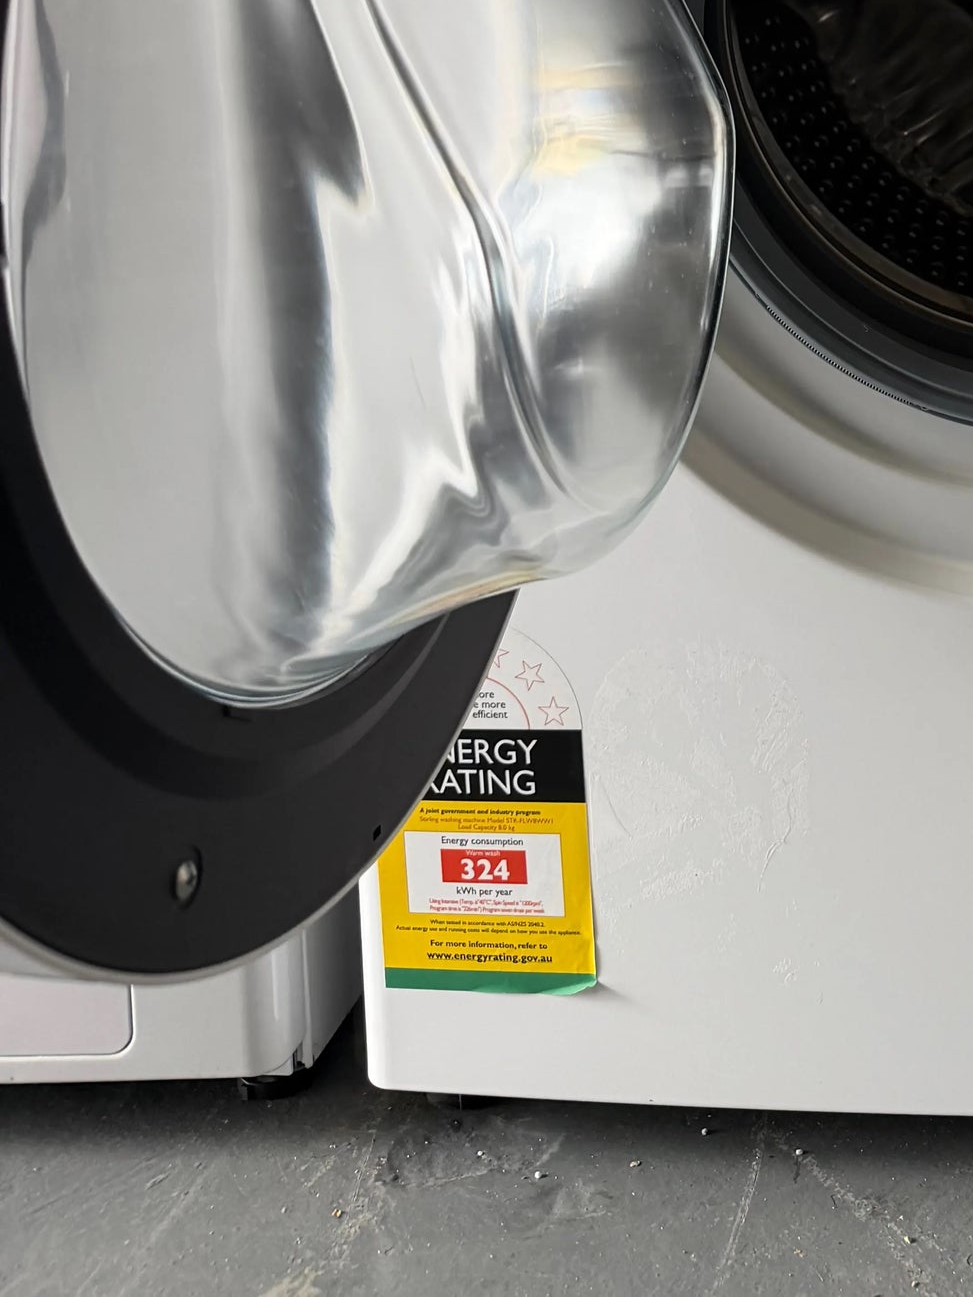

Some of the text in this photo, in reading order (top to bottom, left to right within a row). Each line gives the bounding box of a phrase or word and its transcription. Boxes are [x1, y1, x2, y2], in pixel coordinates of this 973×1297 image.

[472, 710, 508, 719] efficient
[447, 739, 538, 765] ERGY
[430, 769, 536, 795] ATING
[441, 836, 524, 847] Energy consumption
[460, 858, 510, 881] 324
[456, 886, 513, 898] kWh per year
[430, 939, 444, 947] For
[468, 940, 517, 950] information,
[427, 951, 553, 964] www.energyrating.gov.au
